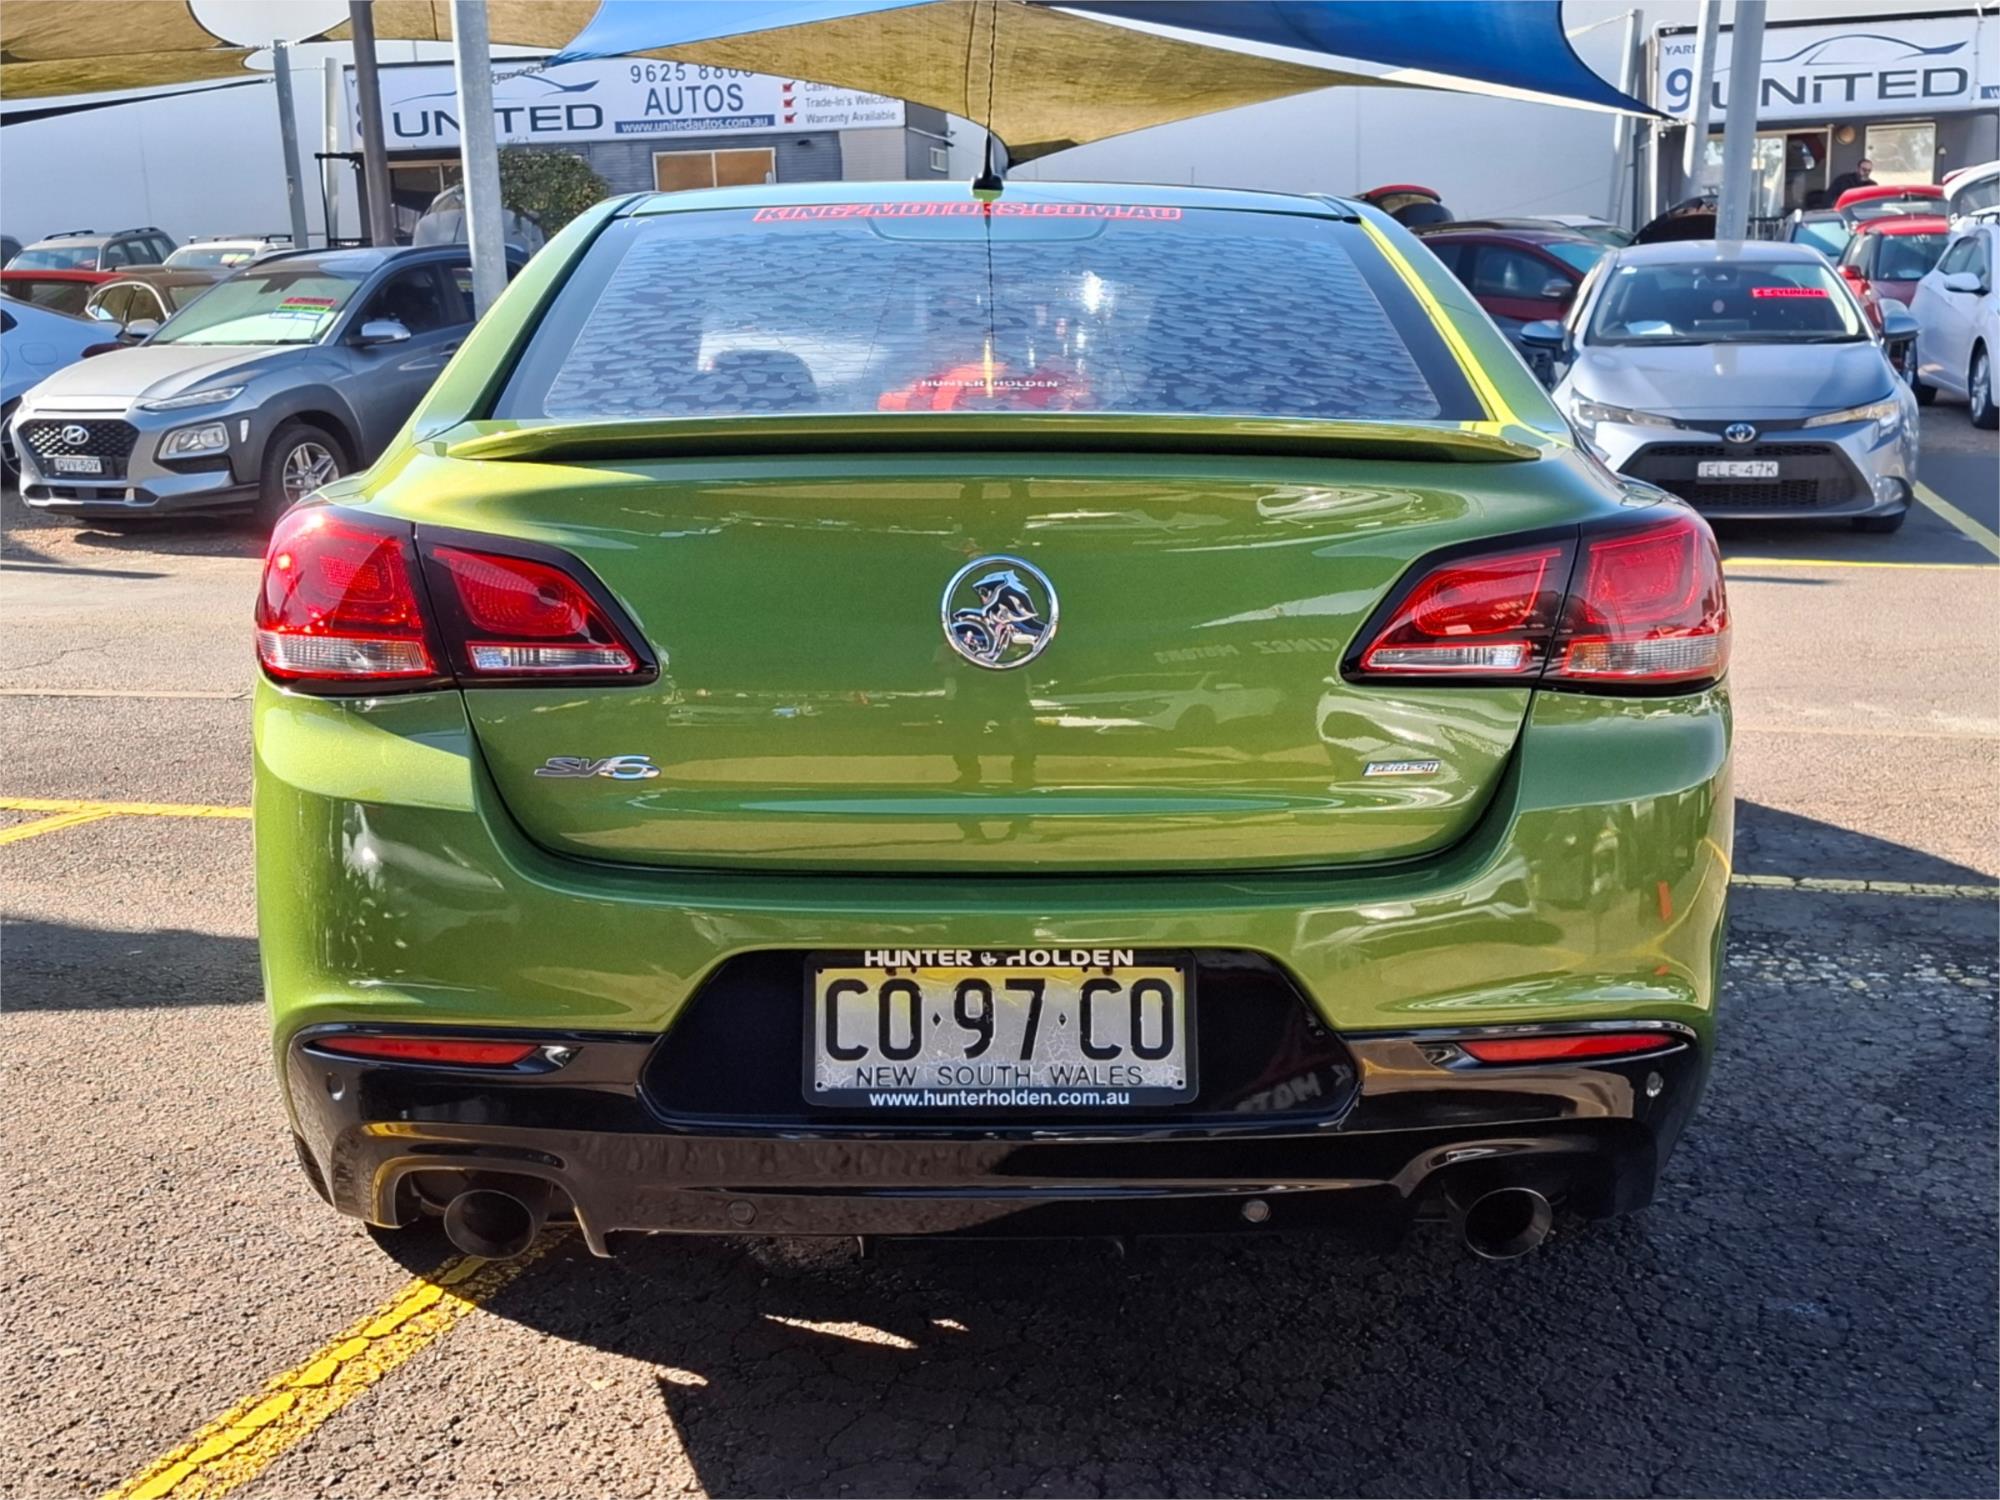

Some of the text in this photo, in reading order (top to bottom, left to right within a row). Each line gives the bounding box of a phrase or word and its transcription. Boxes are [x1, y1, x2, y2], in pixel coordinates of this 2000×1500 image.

[630, 63, 686, 83] 9625
[644, 83, 744, 116] AUTOS
[1665, 67, 1693, 113] 9
[393, 104, 603, 137] UNTED
[621, 117, 768, 133] www.unitedautos.com.au
[806, 110, 897, 125] Warranty Available
[921, 380, 1058, 388] HUNTER HOLDEN
[534, 754, 662, 781] SV6
[864, 949, 1134, 966] HUNTER HOLDEN
[856, 1065, 1143, 1087] NEW SOUTH WALES
[869, 1089, 1130, 1106] www.hunterholden.com.au
